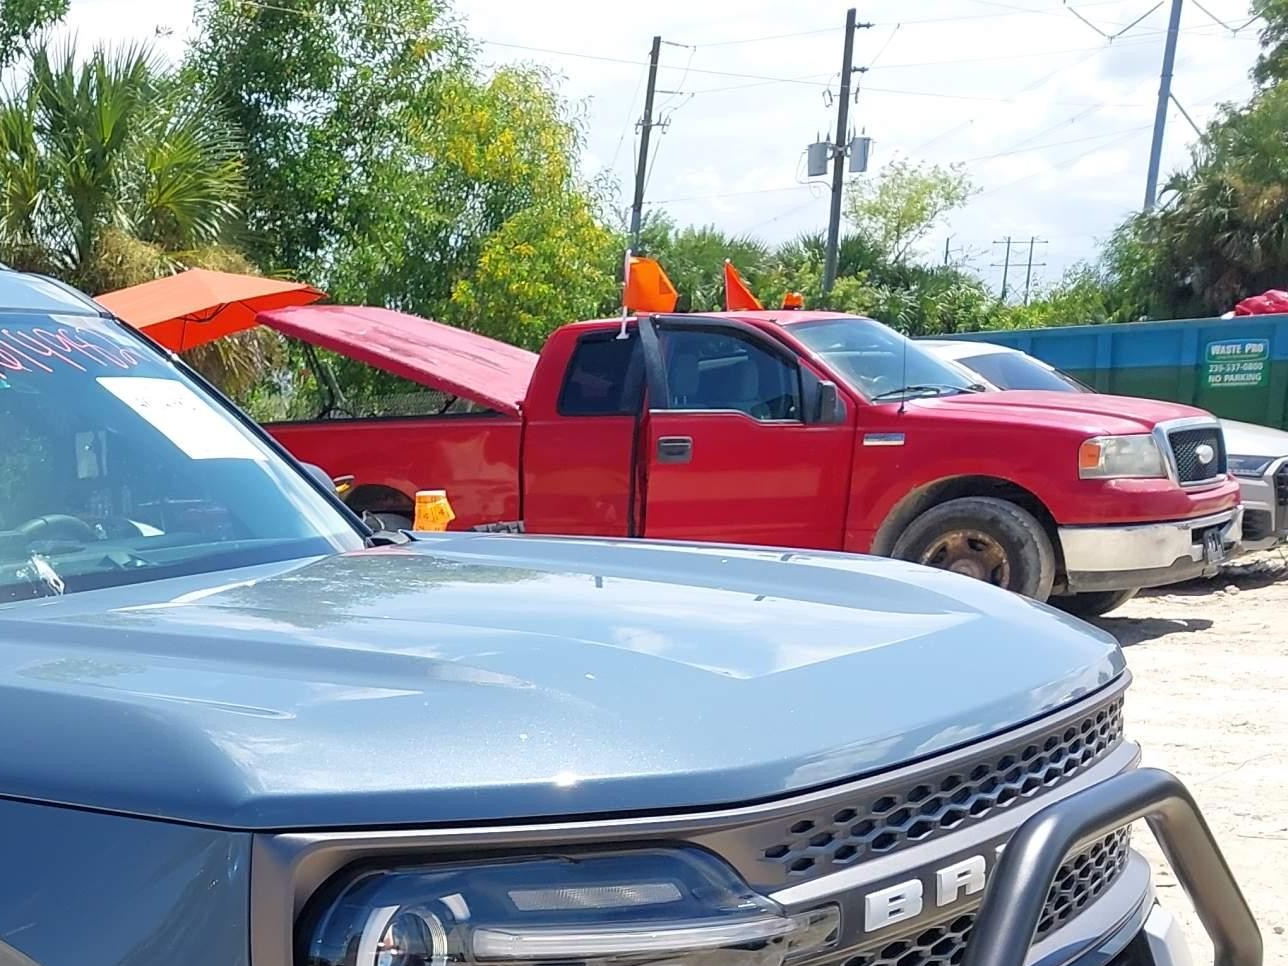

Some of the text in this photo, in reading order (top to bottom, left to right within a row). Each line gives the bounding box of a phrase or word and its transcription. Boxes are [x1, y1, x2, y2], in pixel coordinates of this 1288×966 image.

[1210, 343, 1264, 355] WASTE PRO
[1208, 372, 1262, 383] NO PARKING
